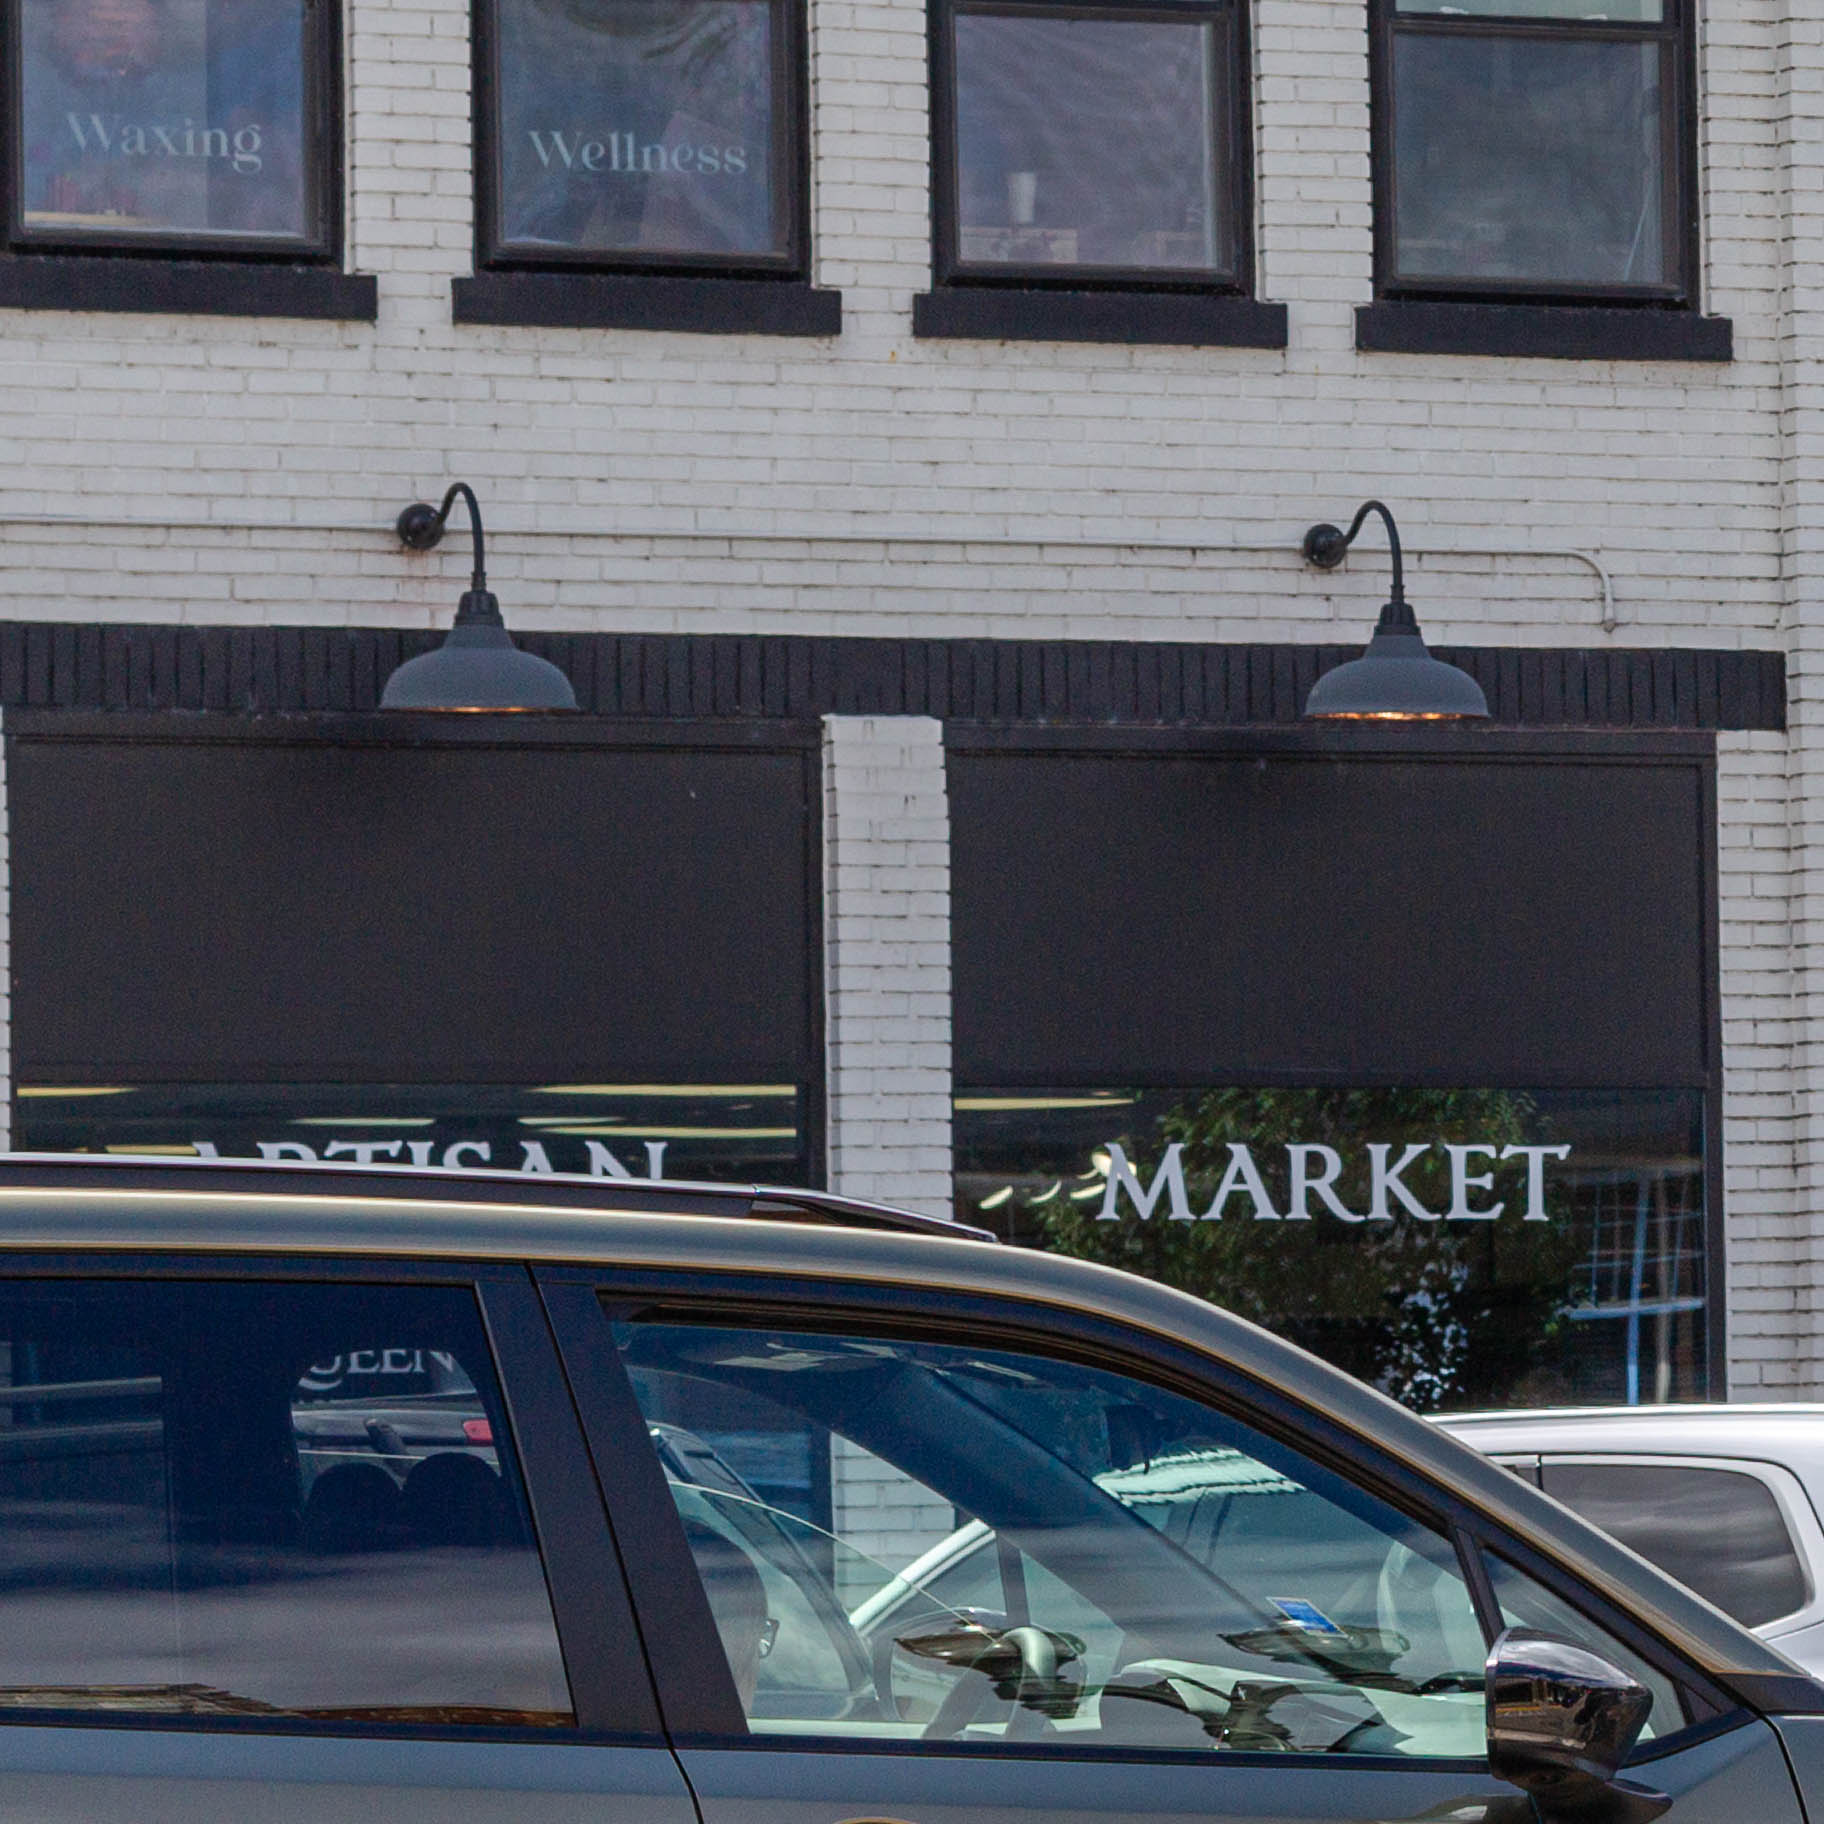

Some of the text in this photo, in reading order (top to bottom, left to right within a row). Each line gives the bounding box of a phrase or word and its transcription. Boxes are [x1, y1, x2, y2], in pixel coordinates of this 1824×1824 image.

[65, 111, 262, 174] Waxing
[530, 130, 748, 174] Wellness
[1095, 1140, 1573, 1222] MARKET
